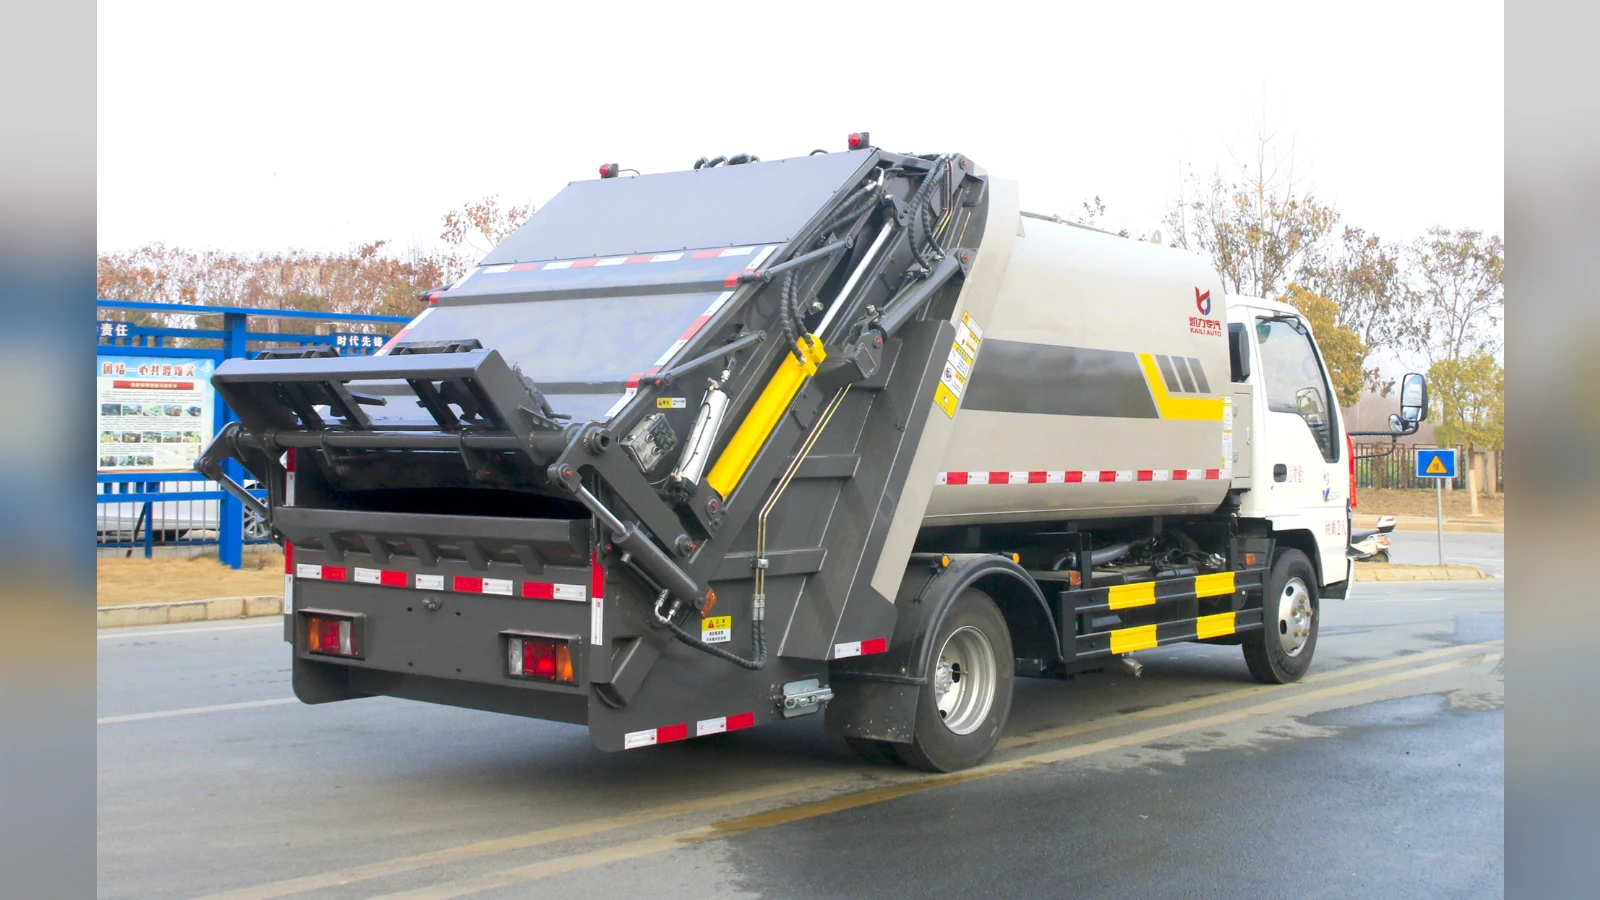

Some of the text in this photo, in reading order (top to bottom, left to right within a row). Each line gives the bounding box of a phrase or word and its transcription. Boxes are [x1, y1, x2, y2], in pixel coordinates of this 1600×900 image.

[96, 322, 128, 337] 责任
[1190, 327, 1222, 337] KAILI AUTO
[336, 335, 383, 347] 时代先锋
